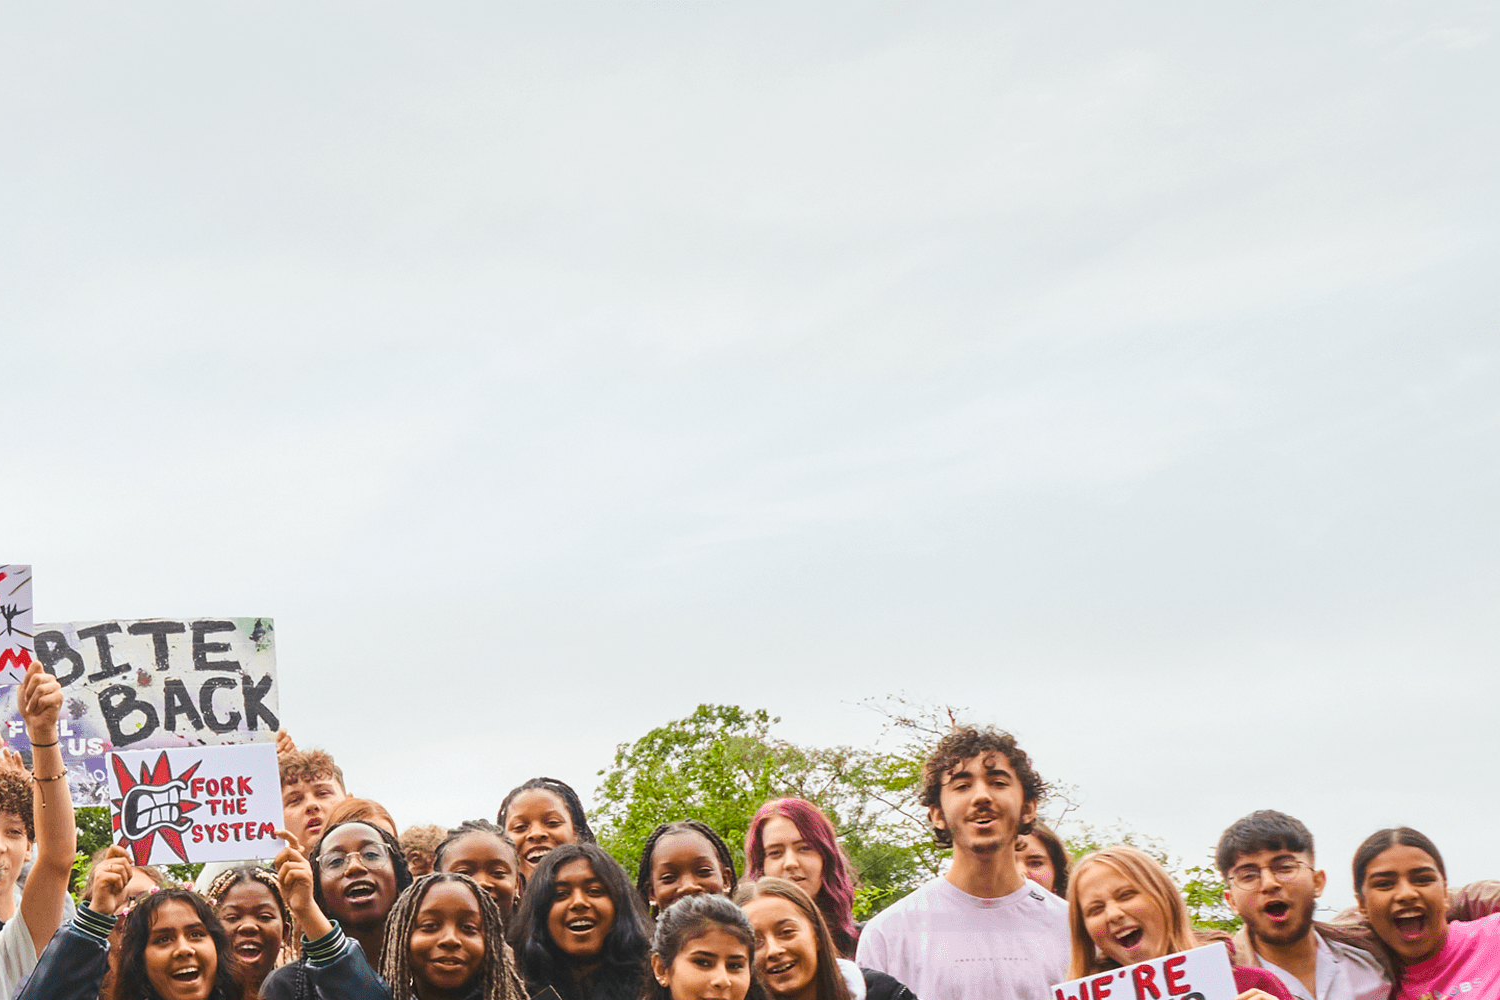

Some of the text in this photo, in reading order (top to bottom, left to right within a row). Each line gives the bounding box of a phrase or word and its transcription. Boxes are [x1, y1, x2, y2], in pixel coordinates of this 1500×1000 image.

[33, 620, 244, 688] BITE
[98, 674, 280, 747] BACK
[8, 719, 74, 738] FL
[68, 738, 104, 756] US
[191, 775, 253, 799] FORK
[205, 797, 248, 816] THE
[191, 821, 277, 843] SYSTEM
